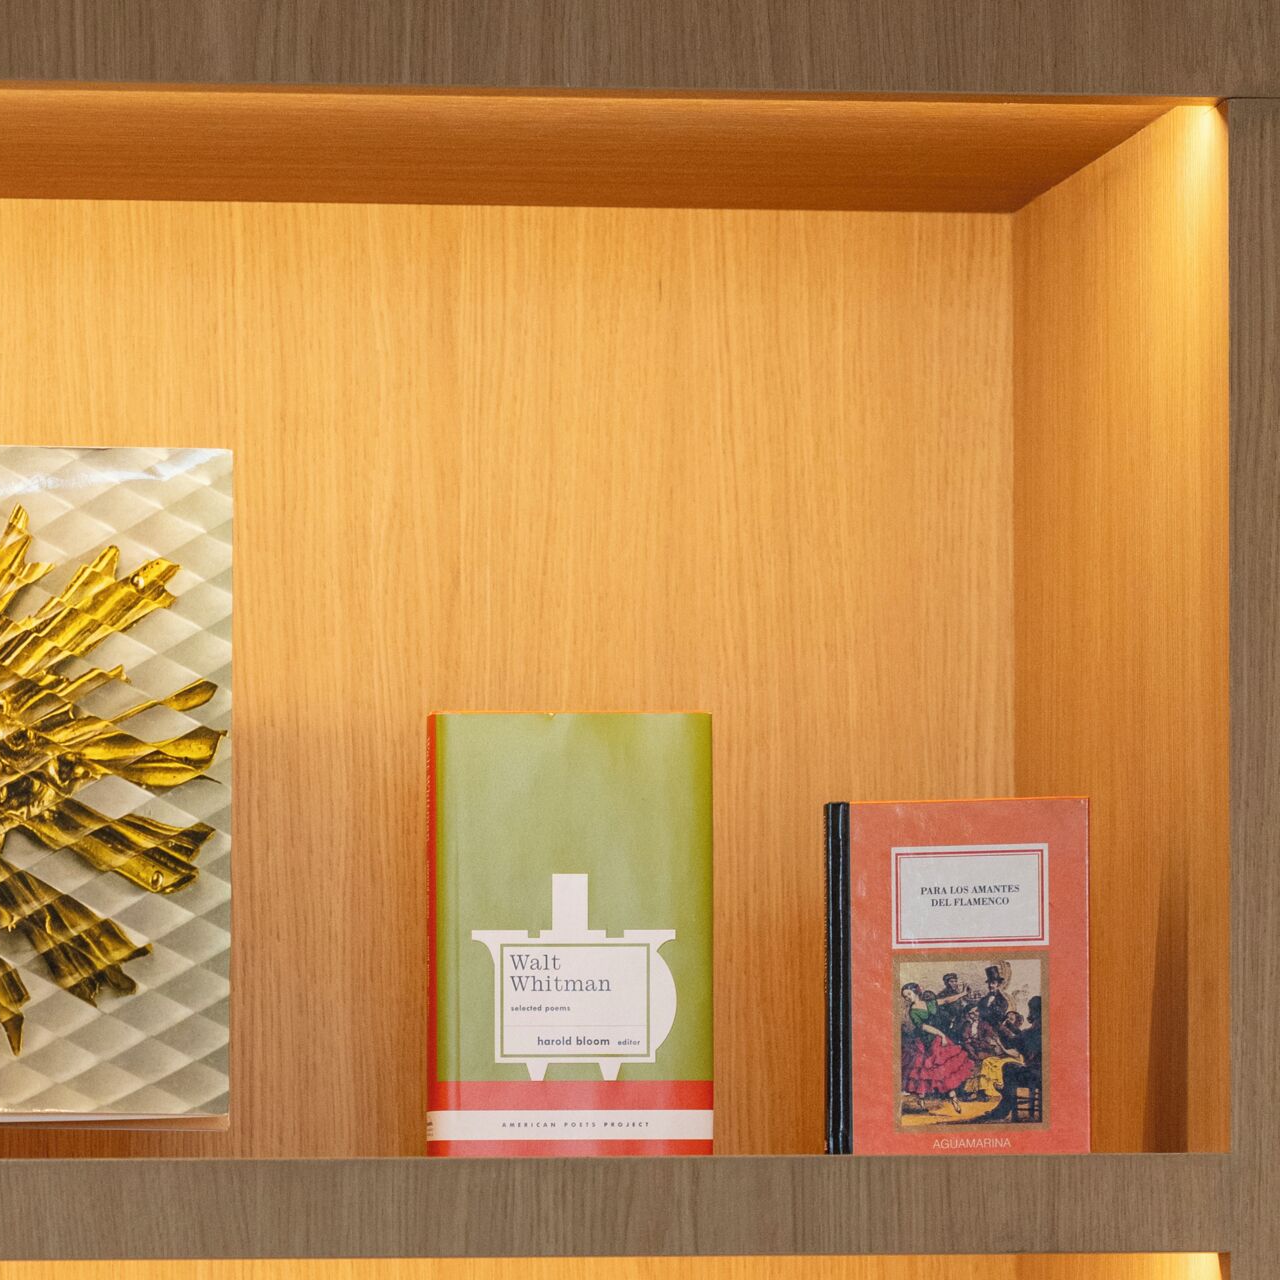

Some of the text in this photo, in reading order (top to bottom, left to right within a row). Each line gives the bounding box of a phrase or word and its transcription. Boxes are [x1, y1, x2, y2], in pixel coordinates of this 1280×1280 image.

[920, 884, 1020, 896] PARA LOS AMANTES
[931, 896, 1010, 907] DEL FLAMENCO
[509, 953, 562, 972] Walt
[509, 975, 612, 992] Whitman
[510, 1004, 571, 1013] selected poems
[537, 1035, 641, 1046] harold bloom editor
[932, 1137, 1013, 1150] AGUAMARINA
